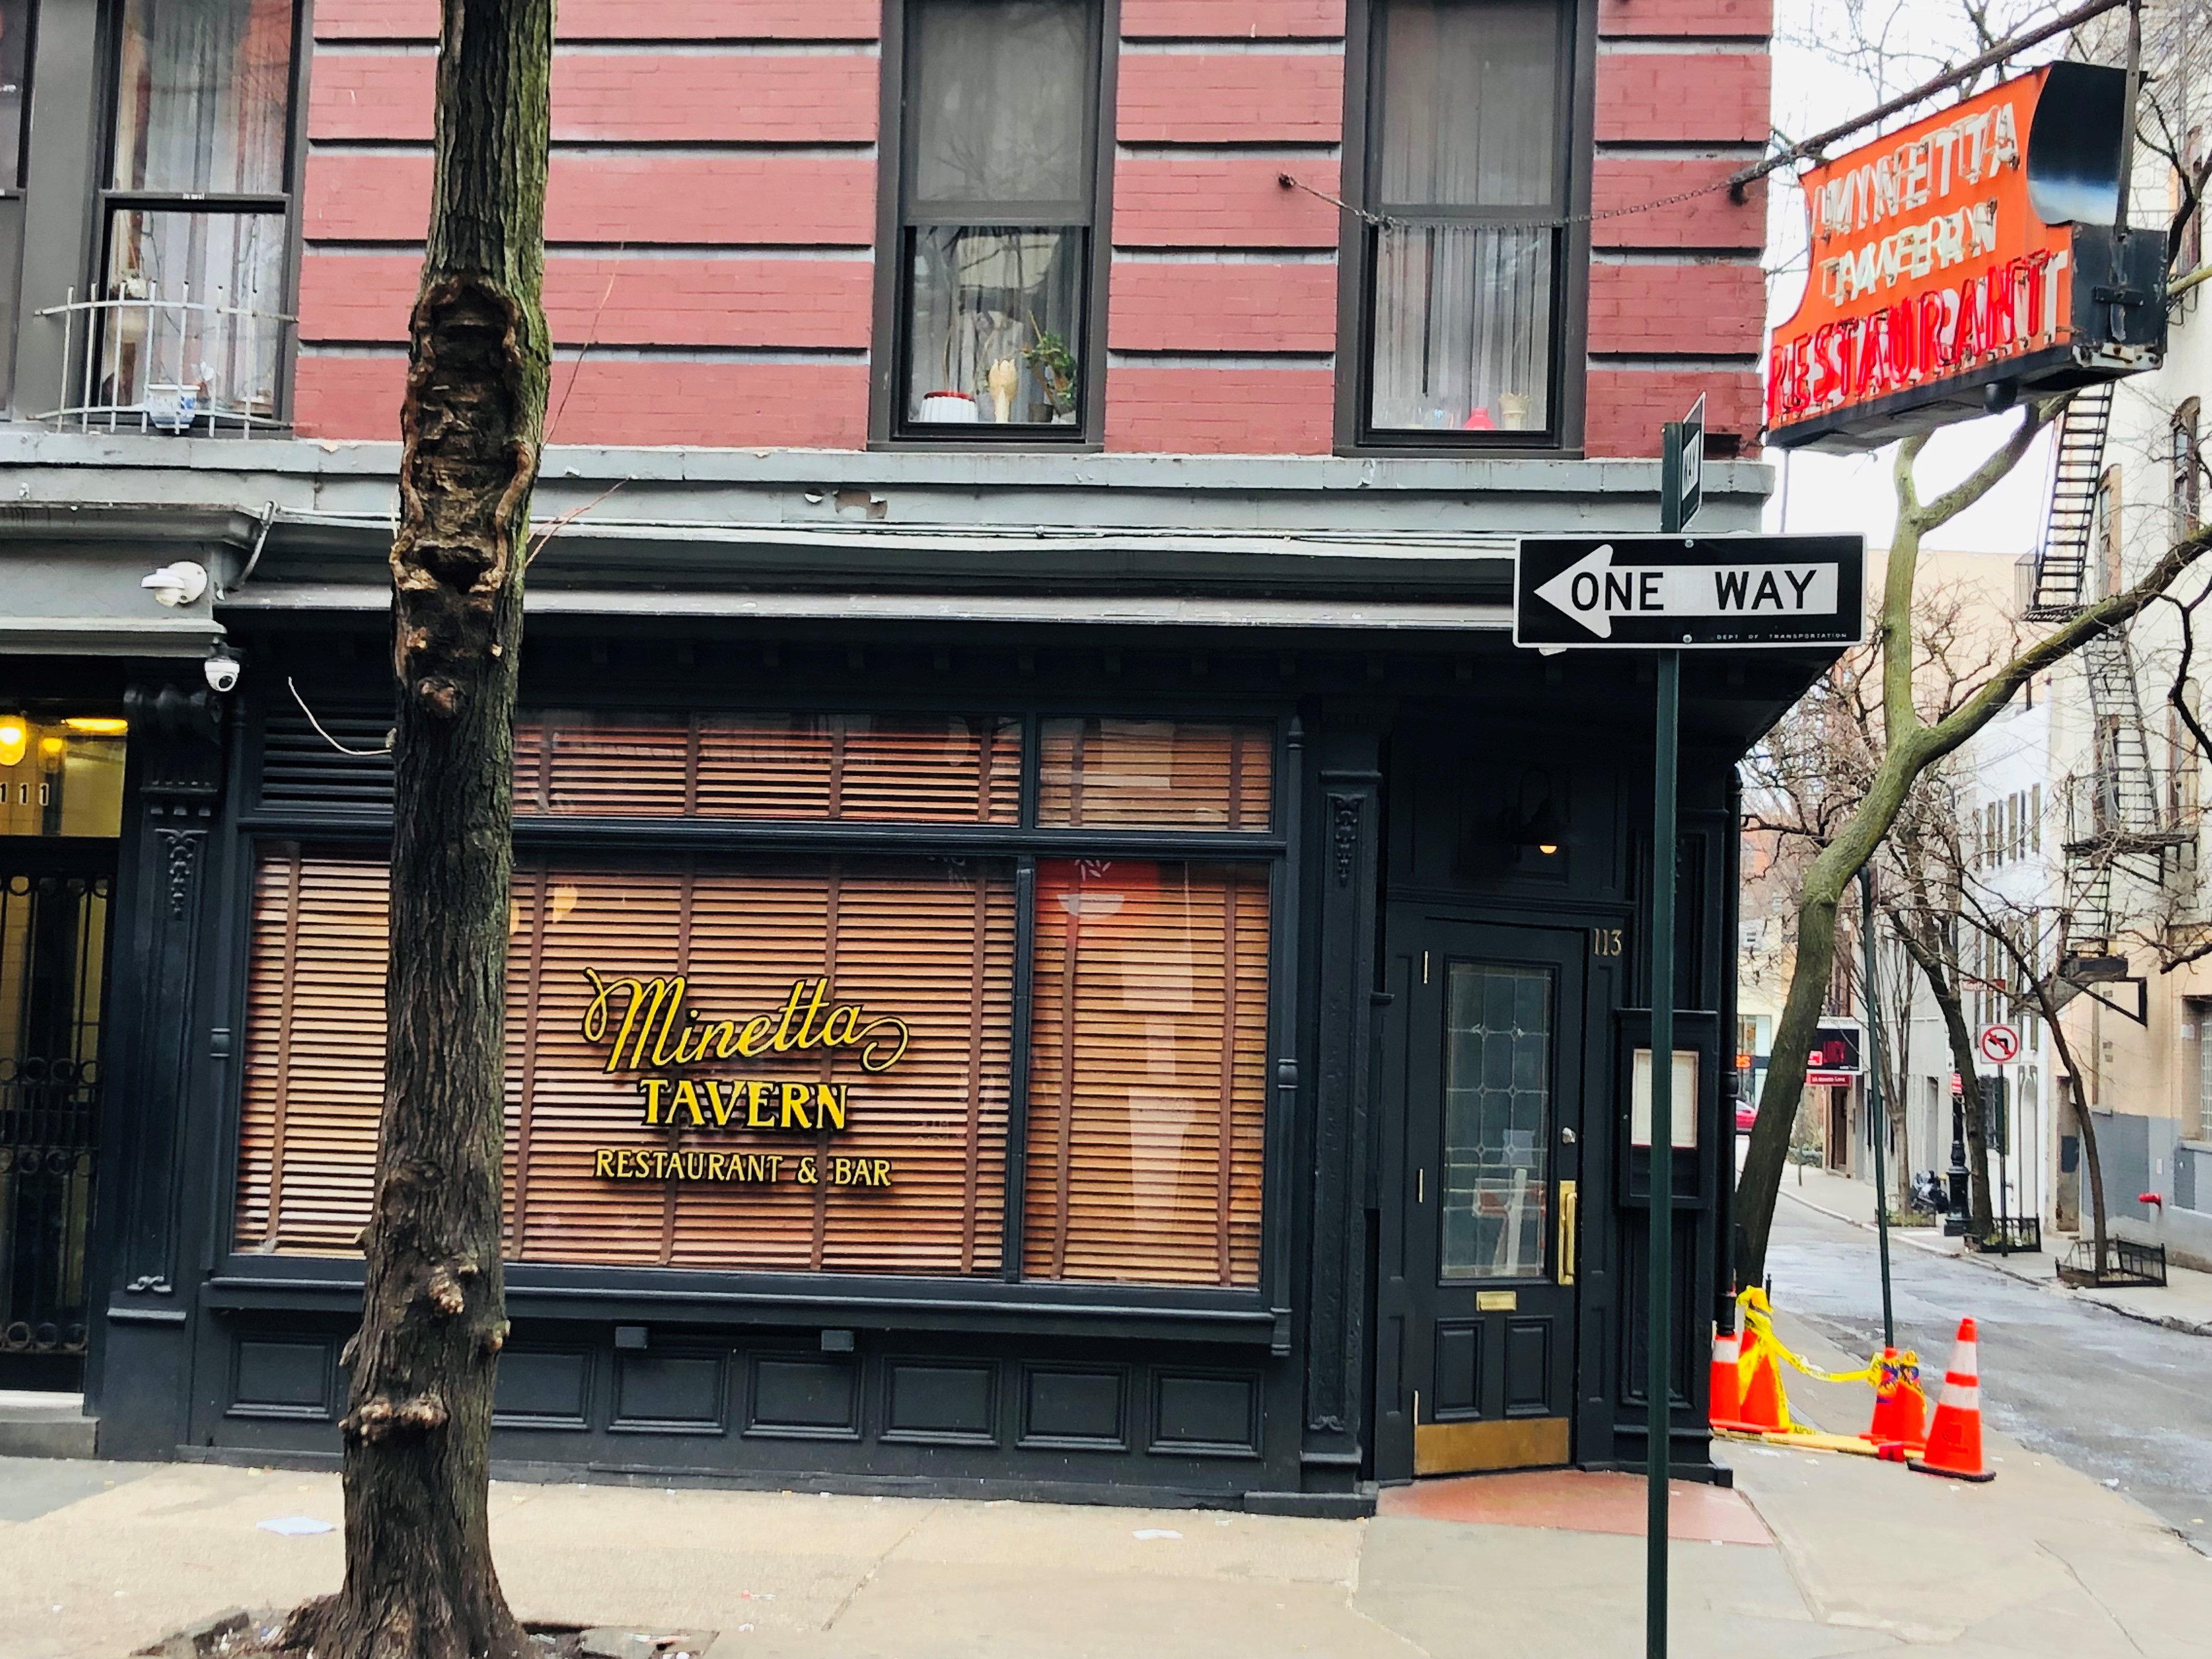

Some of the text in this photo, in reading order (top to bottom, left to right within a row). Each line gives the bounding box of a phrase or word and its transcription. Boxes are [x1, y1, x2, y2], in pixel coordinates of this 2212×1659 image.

[1811, 102, 2020, 235] MINETTA
[1818, 200, 1998, 308] TAVERN
[1767, 248, 2069, 421] RESTAURANT
[1571, 569, 1818, 612] ONE WAY
[1593, 928, 1622, 956] 113
[582, 967, 910, 1074] Minetta
[637, 1078, 849, 1130] TAVERN
[594, 1149, 892, 1188] RESTAURANT & BAR
